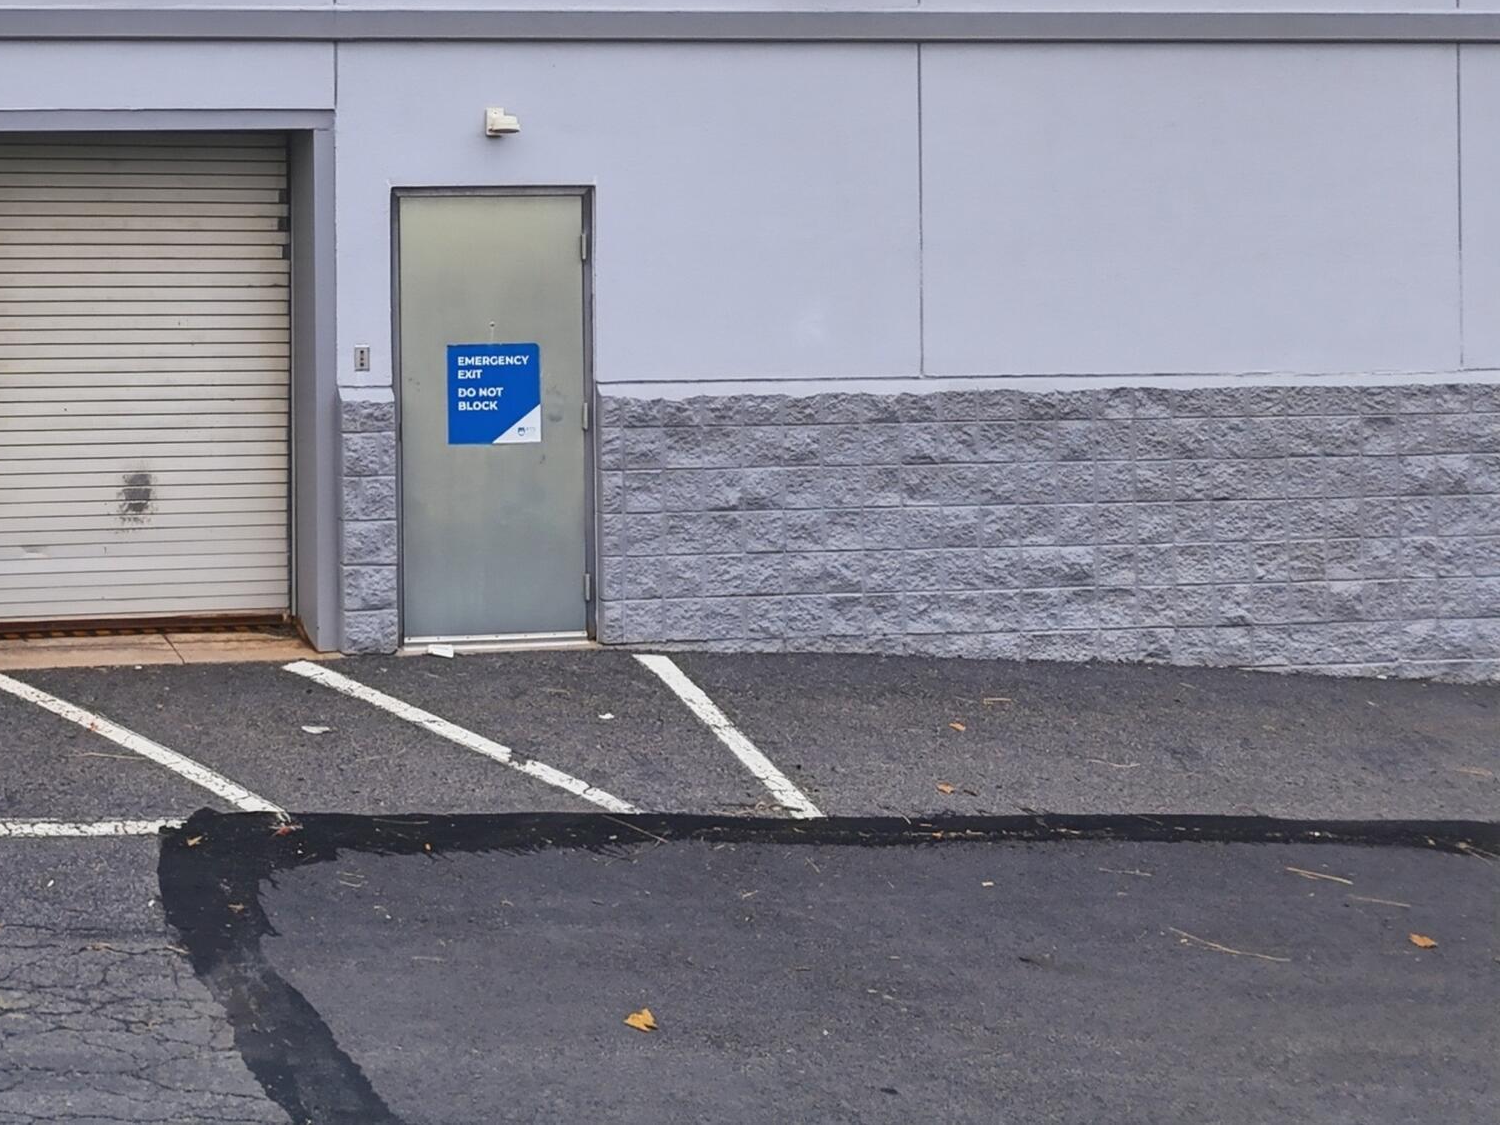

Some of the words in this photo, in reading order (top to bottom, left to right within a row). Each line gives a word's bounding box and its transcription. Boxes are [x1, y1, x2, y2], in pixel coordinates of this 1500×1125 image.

[457, 355, 529, 366] EMERGENCY
[457, 369, 483, 379] EXIT
[457, 387, 476, 397] DO
[479, 387, 504, 397] NOT
[457, 400, 498, 411] BLOCK
